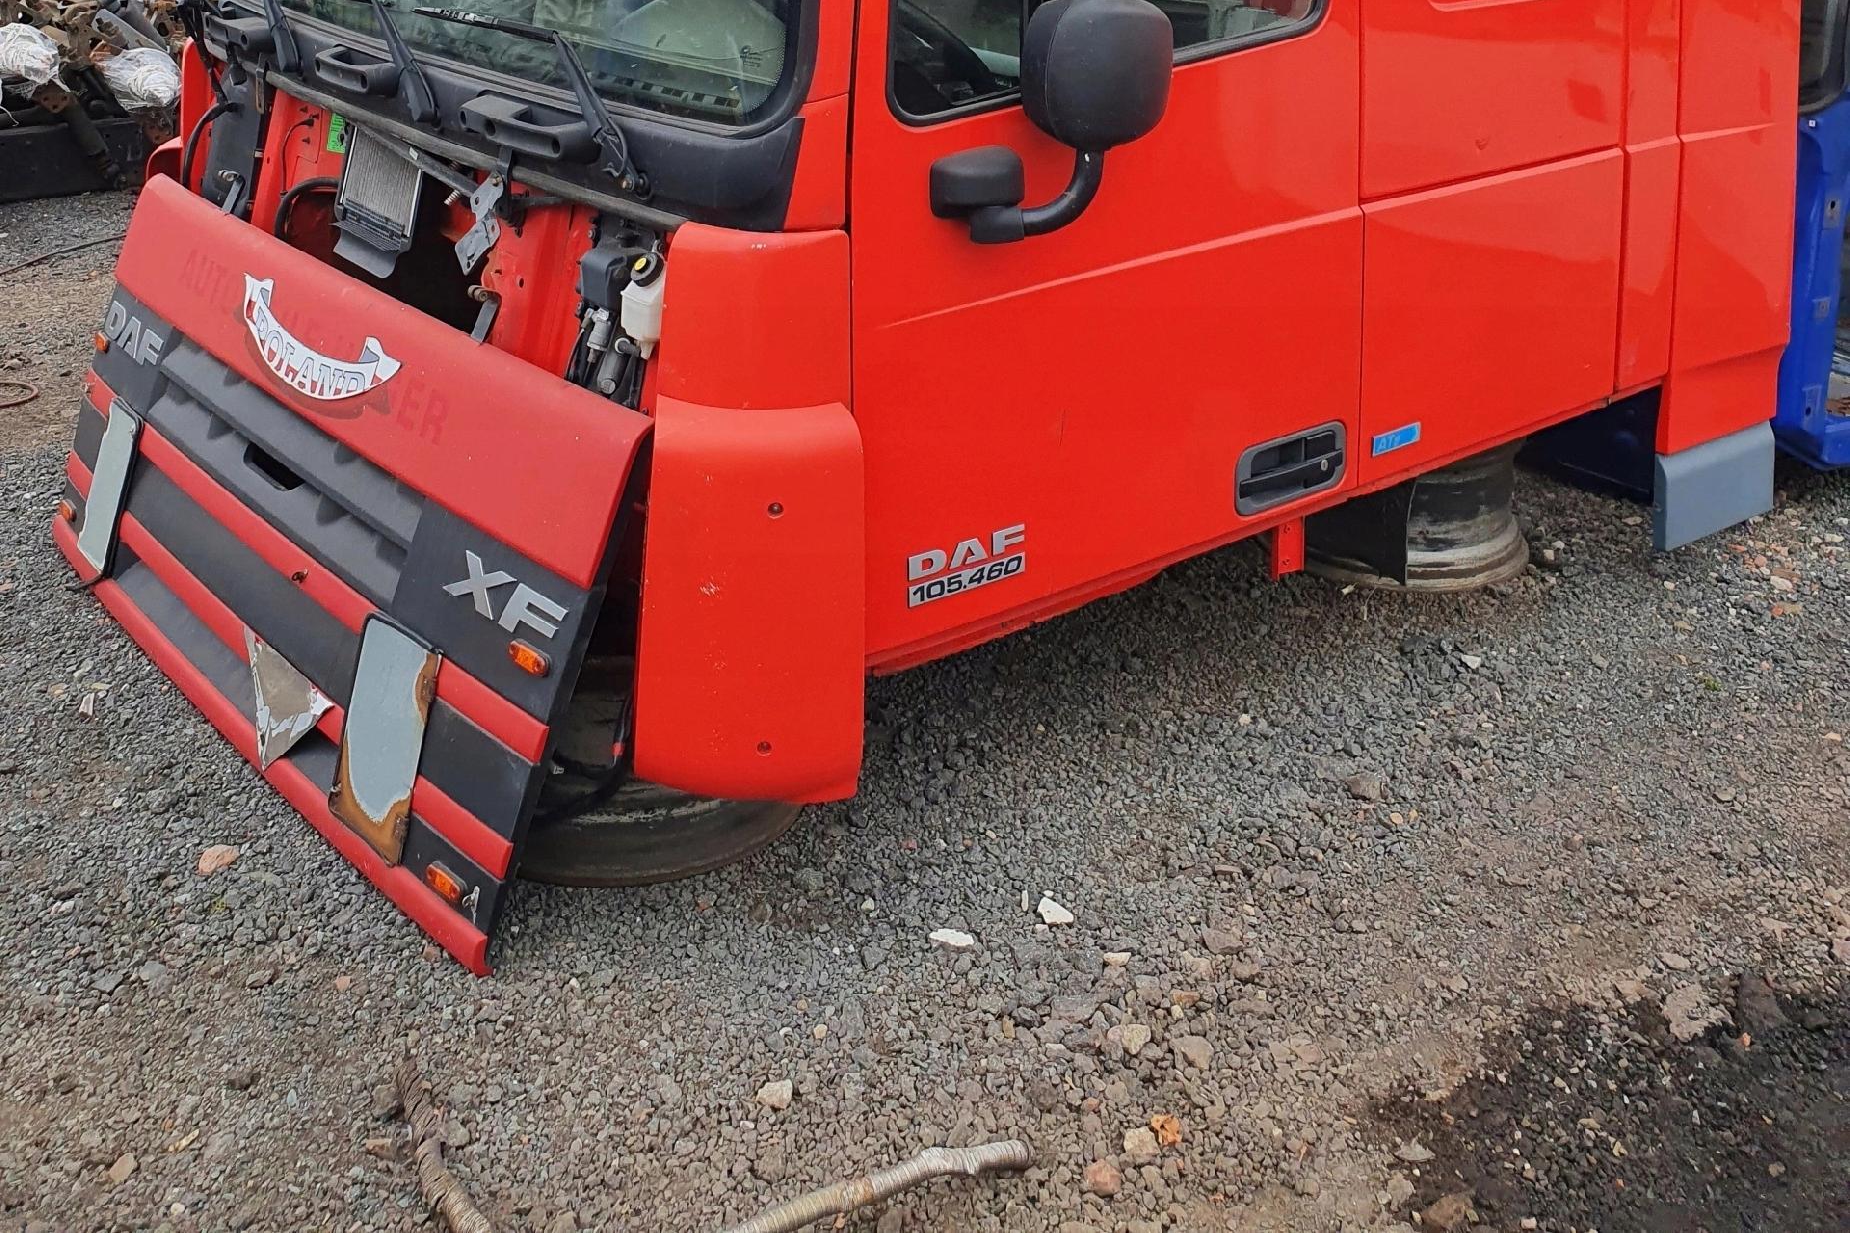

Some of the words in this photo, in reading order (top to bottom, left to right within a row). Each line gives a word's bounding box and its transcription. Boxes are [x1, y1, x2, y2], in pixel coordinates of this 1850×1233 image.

[105, 300, 164, 366] DAF
[256, 307, 367, 397] POLAND
[907, 523, 1025, 582] DAF
[912, 555, 1023, 602] 105.460
[442, 549, 569, 639] XF
